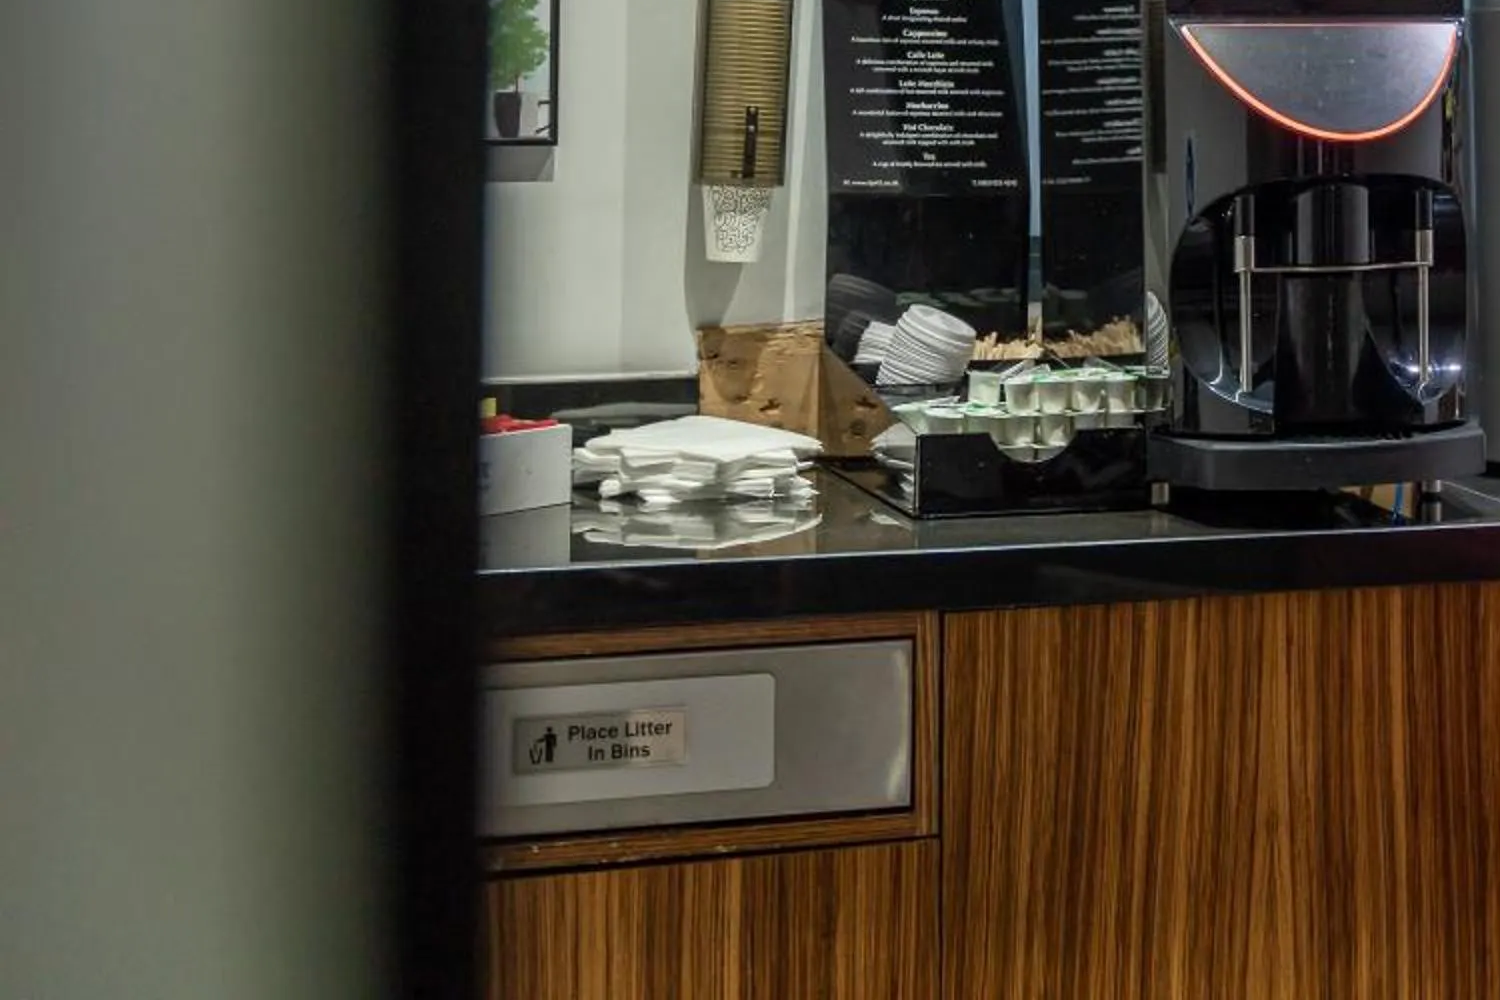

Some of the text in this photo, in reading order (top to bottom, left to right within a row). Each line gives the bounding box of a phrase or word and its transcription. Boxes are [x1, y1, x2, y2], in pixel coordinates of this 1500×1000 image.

[567, 721, 673, 742] Place Litter
[588, 743, 651, 761] In Bins
